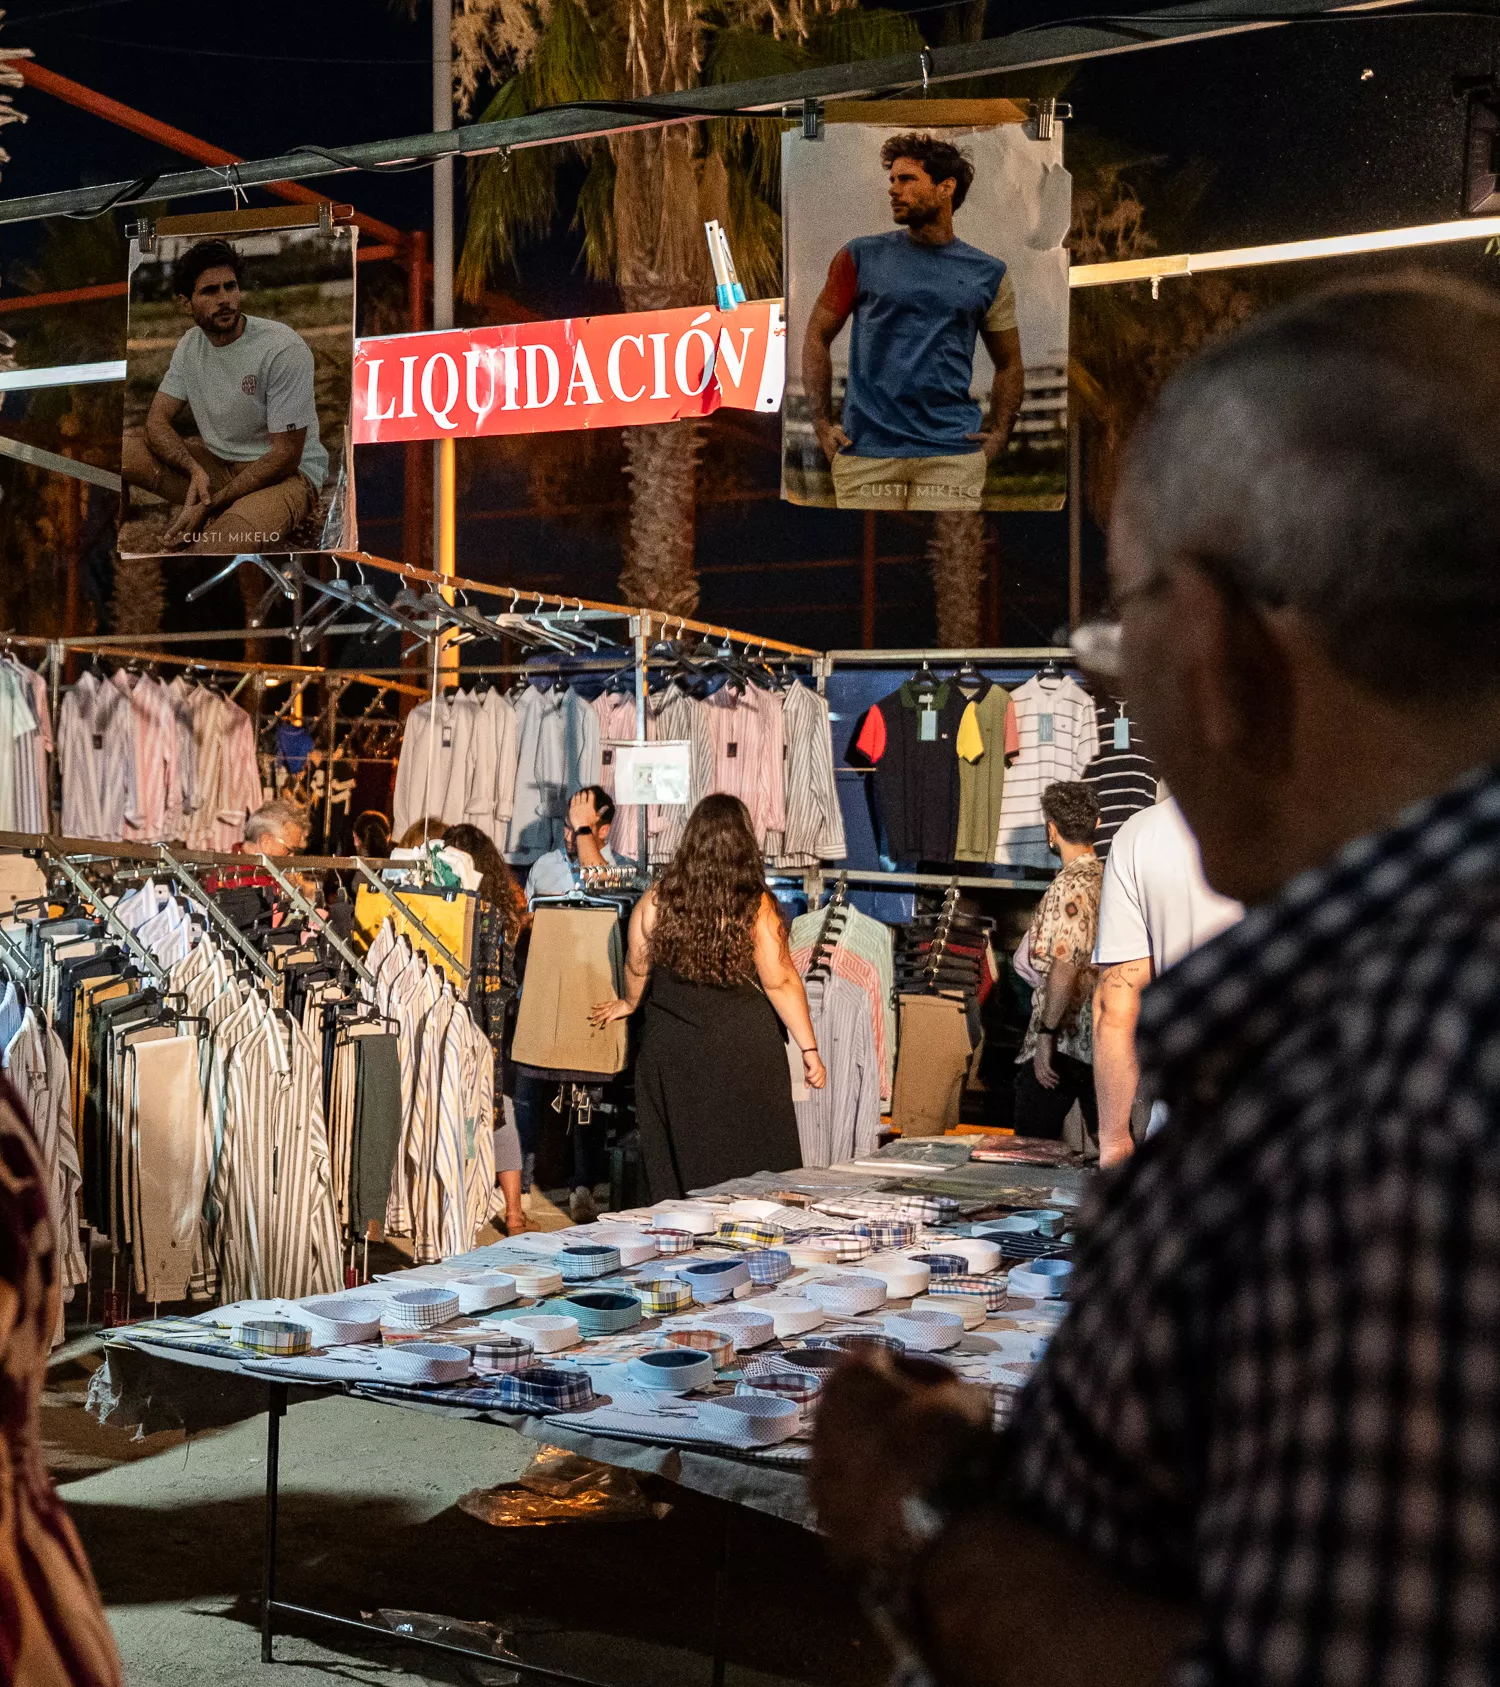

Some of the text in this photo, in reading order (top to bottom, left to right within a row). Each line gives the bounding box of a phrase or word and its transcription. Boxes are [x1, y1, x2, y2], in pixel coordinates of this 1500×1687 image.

[363, 311, 754, 430] LIQUIDACIÓN
[860, 483, 982, 498] CUSTI MIKELO
[183, 531, 280, 543] CUSTI MIKELO
